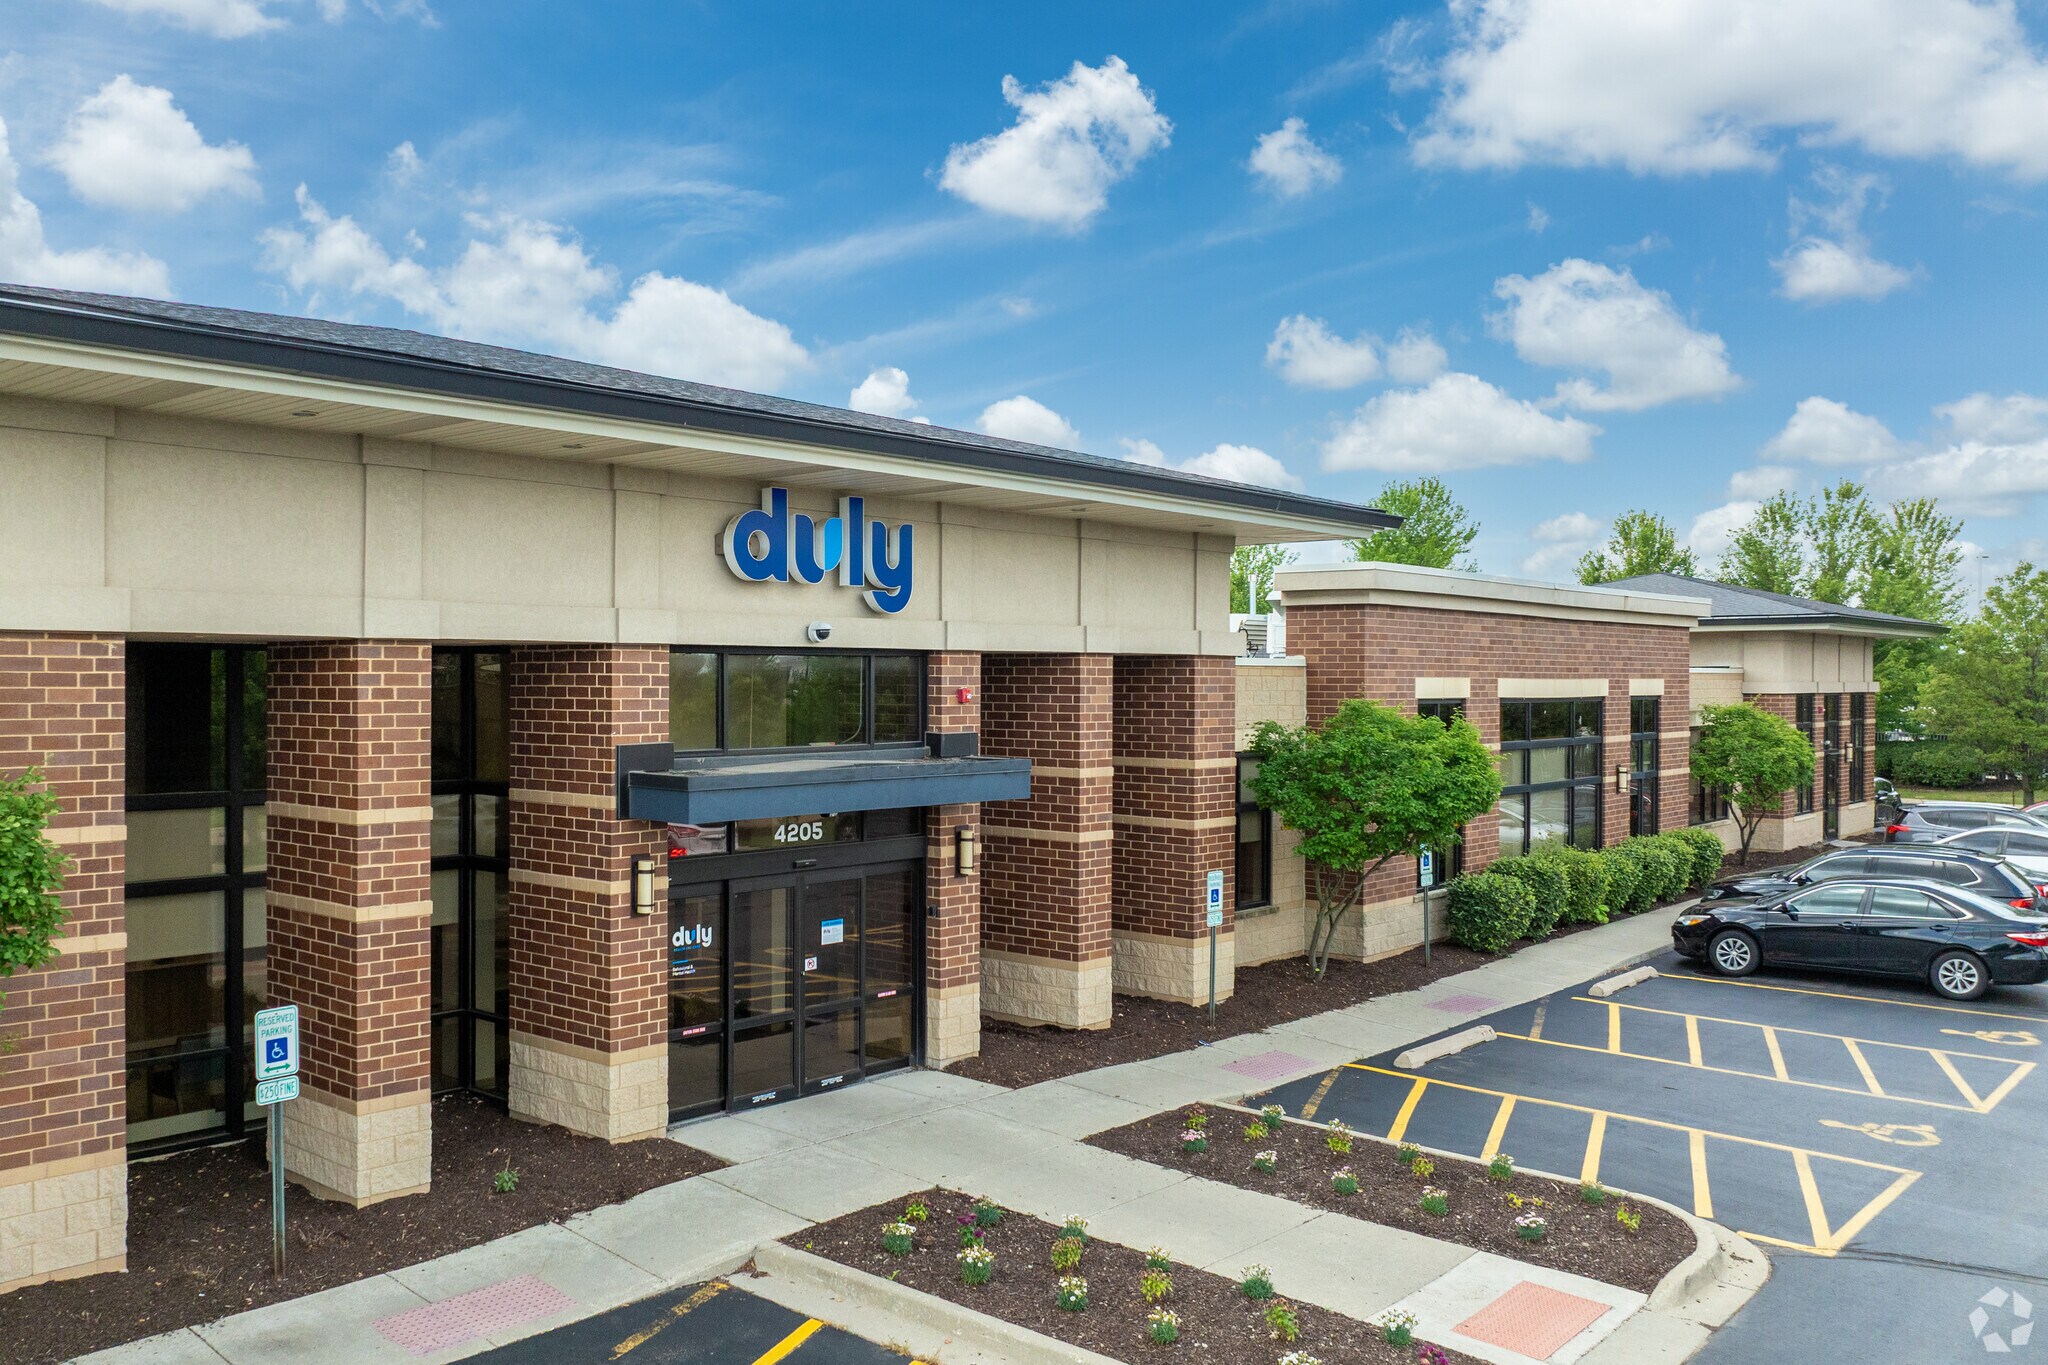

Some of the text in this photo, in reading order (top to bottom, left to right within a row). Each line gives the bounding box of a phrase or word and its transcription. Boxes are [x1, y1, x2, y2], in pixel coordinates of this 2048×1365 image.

[723, 487, 914, 614] duly
[774, 822, 823, 842] 4205
[672, 924, 713, 948] duly
[258, 1012, 294, 1027] RESERVED
[261, 1025, 293, 1038] PARKING
[260, 1081, 296, 1099] $250 FINE
